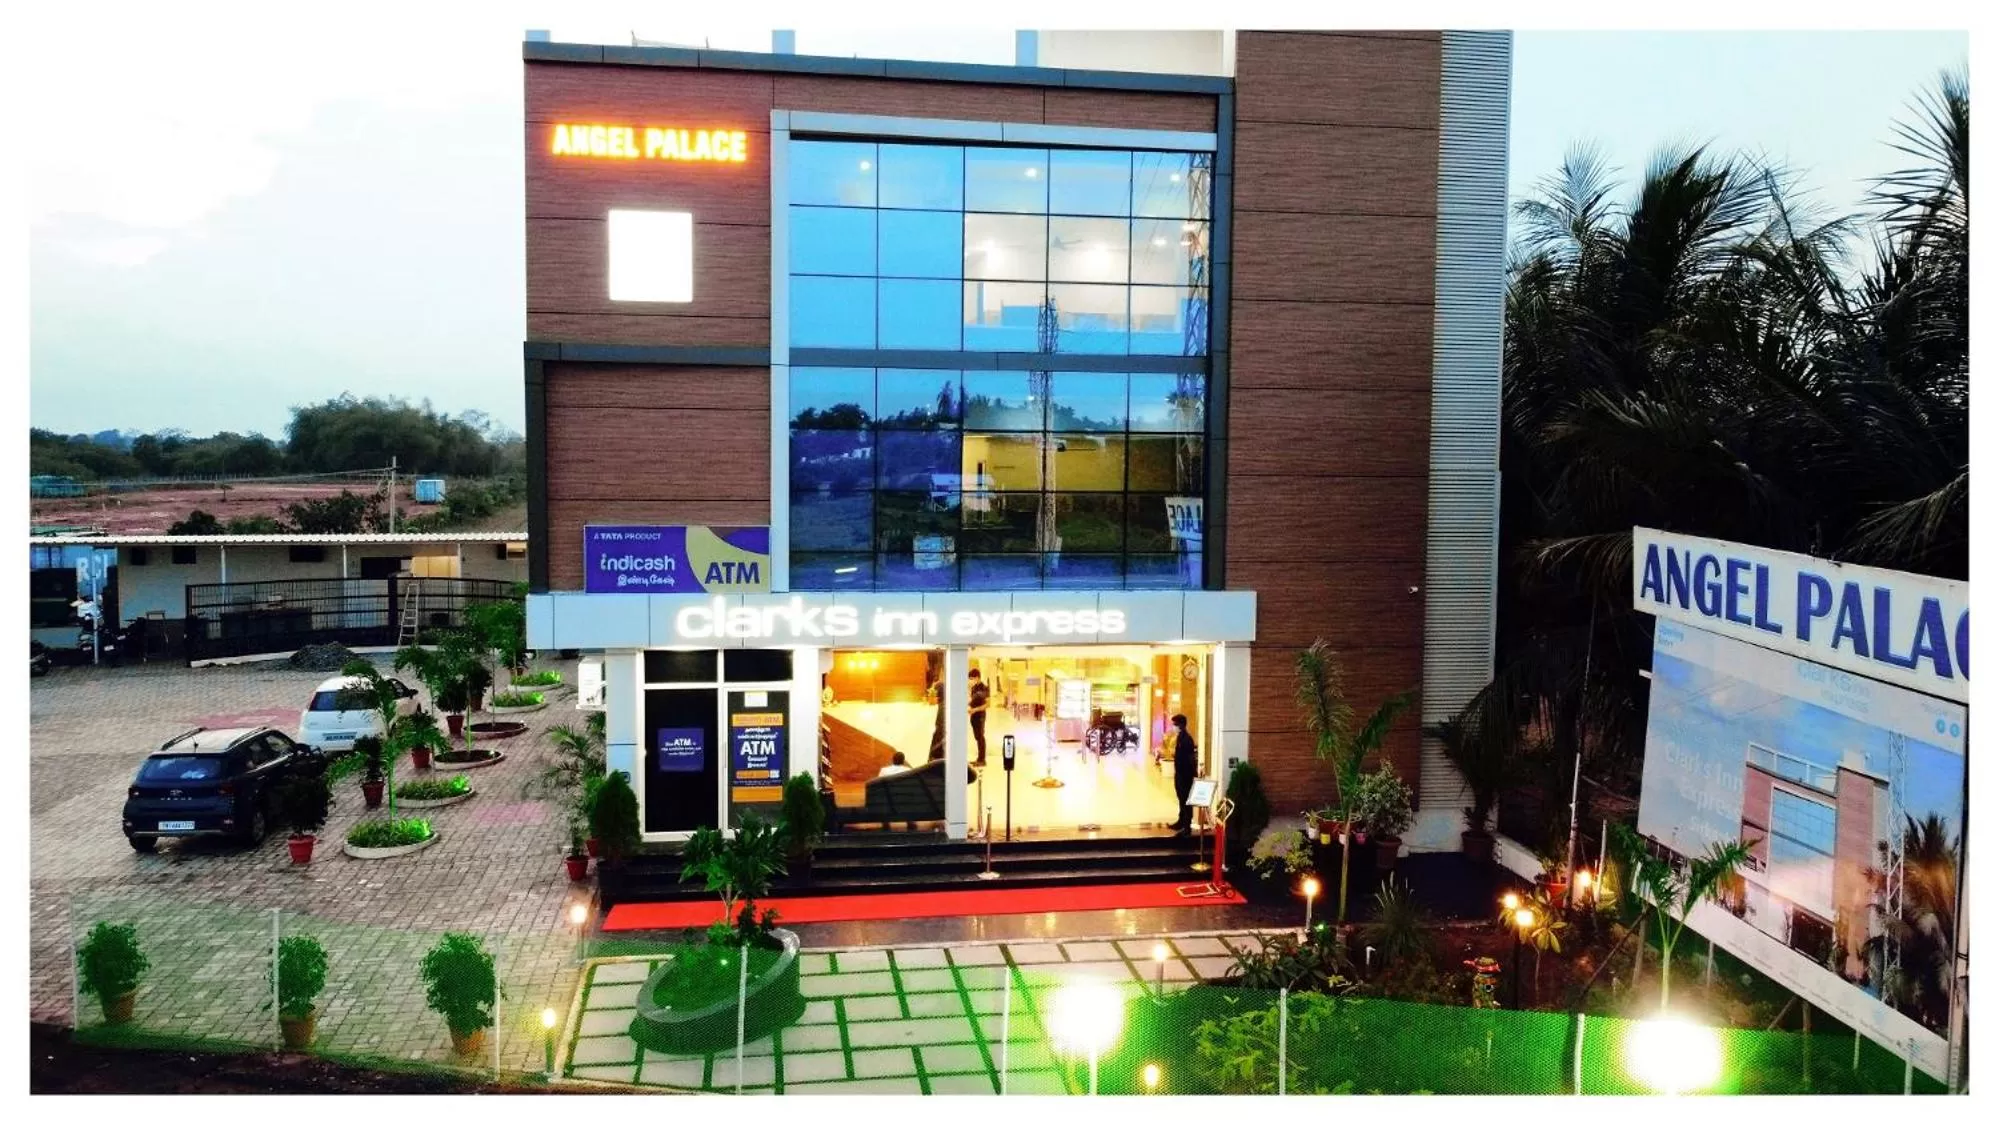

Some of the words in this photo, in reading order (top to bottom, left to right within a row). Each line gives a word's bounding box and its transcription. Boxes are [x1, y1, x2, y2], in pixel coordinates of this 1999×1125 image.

[552, 124, 640, 157] ANGEL
[645, 128, 747, 161] PALACE
[600, 532, 623, 540] TATA
[624, 532, 661, 540] PRODUCT
[600, 553, 676, 571] indicash
[704, 561, 760, 584] ATM
[1640, 543, 1783, 635] ANGEL
[676, 595, 859, 638] clarks
[872, 607, 938, 637] inn
[950, 609, 1126, 642] express
[740, 740, 776, 756] ATM
